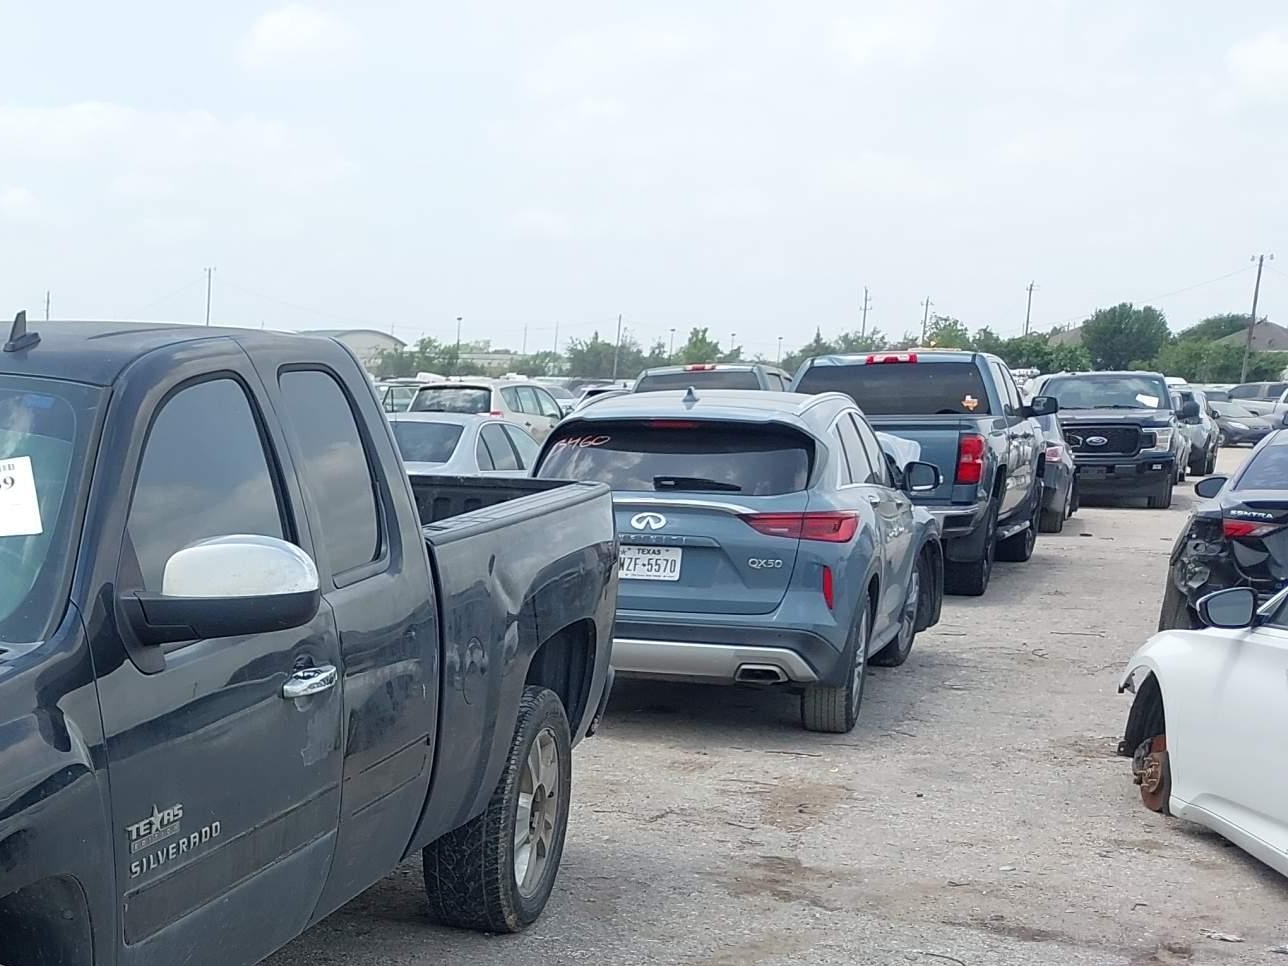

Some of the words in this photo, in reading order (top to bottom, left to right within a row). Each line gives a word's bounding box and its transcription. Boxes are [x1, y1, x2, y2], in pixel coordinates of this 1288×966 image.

[637, 548, 662, 557] TEXAS
[747, 558, 783, 569] QX50
[125, 803, 183, 840] TEXAS
[130, 821, 221, 879] SILVERADO
